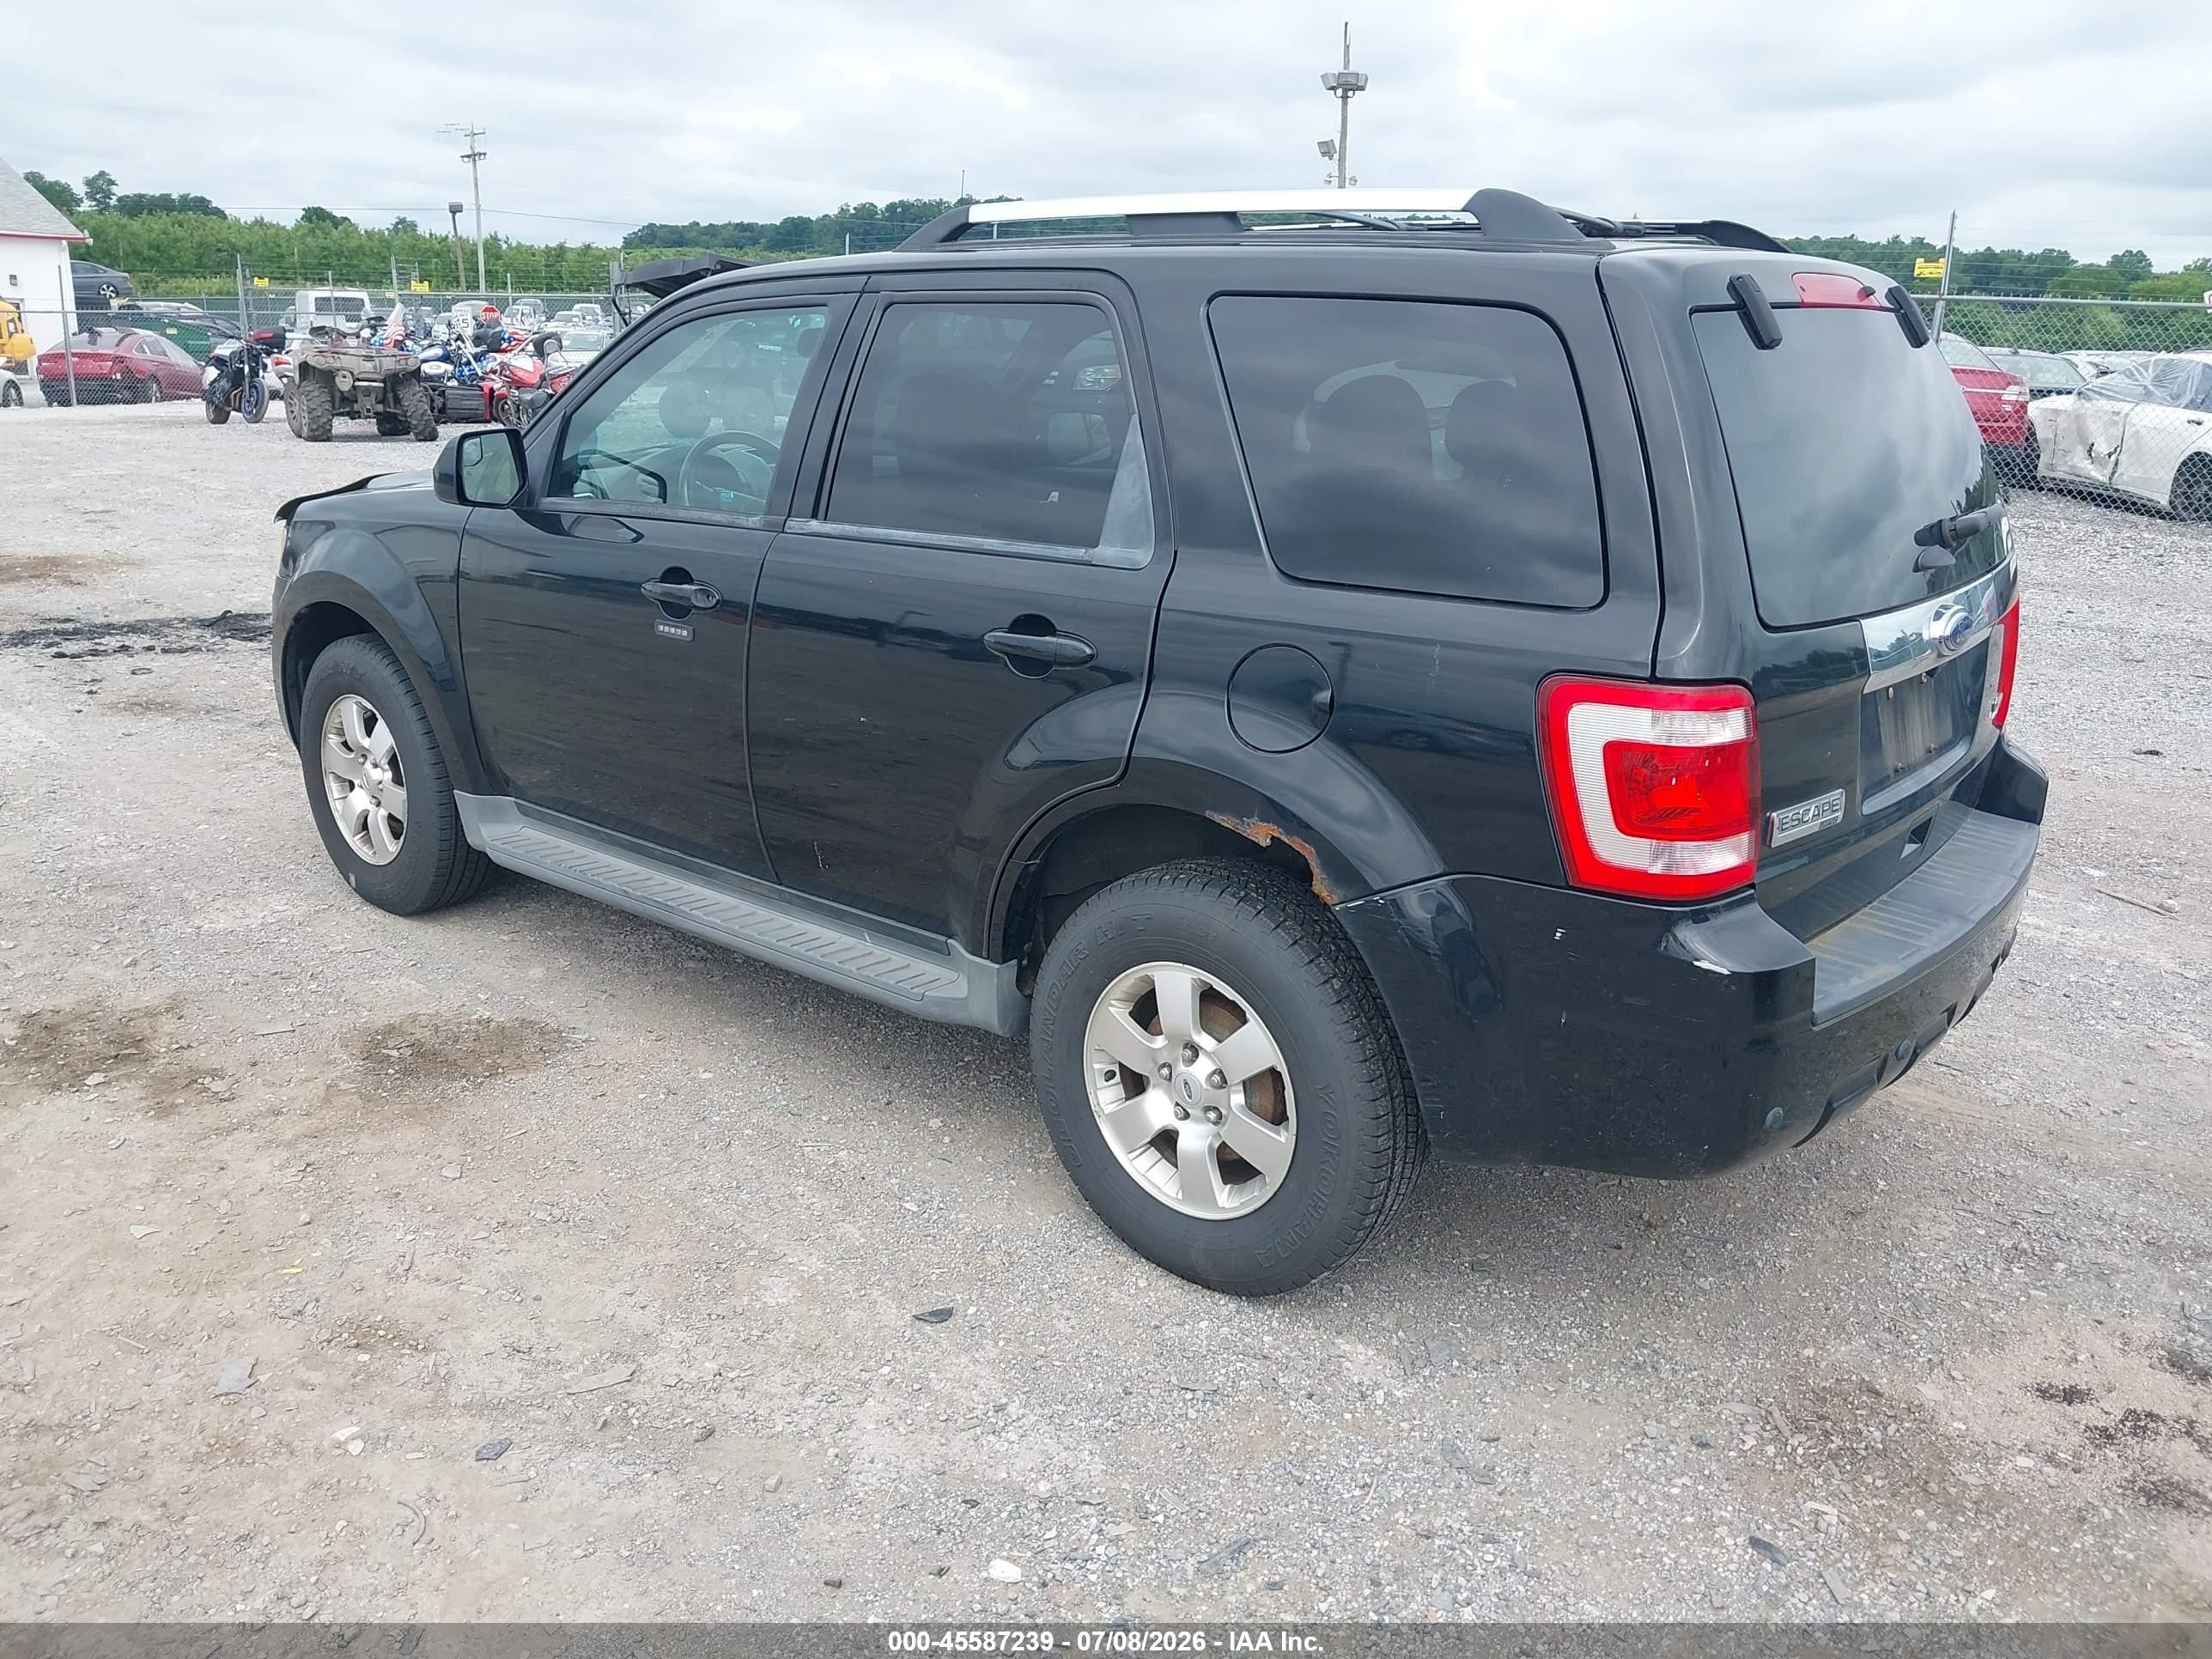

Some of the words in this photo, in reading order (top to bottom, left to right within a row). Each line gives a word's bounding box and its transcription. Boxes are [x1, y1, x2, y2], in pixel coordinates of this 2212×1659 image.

[481, 312, 499, 320] STOP
[1780, 796, 1841, 831] ESCAPE
[1254, 1084, 1340, 1267] YOKOHAMA
